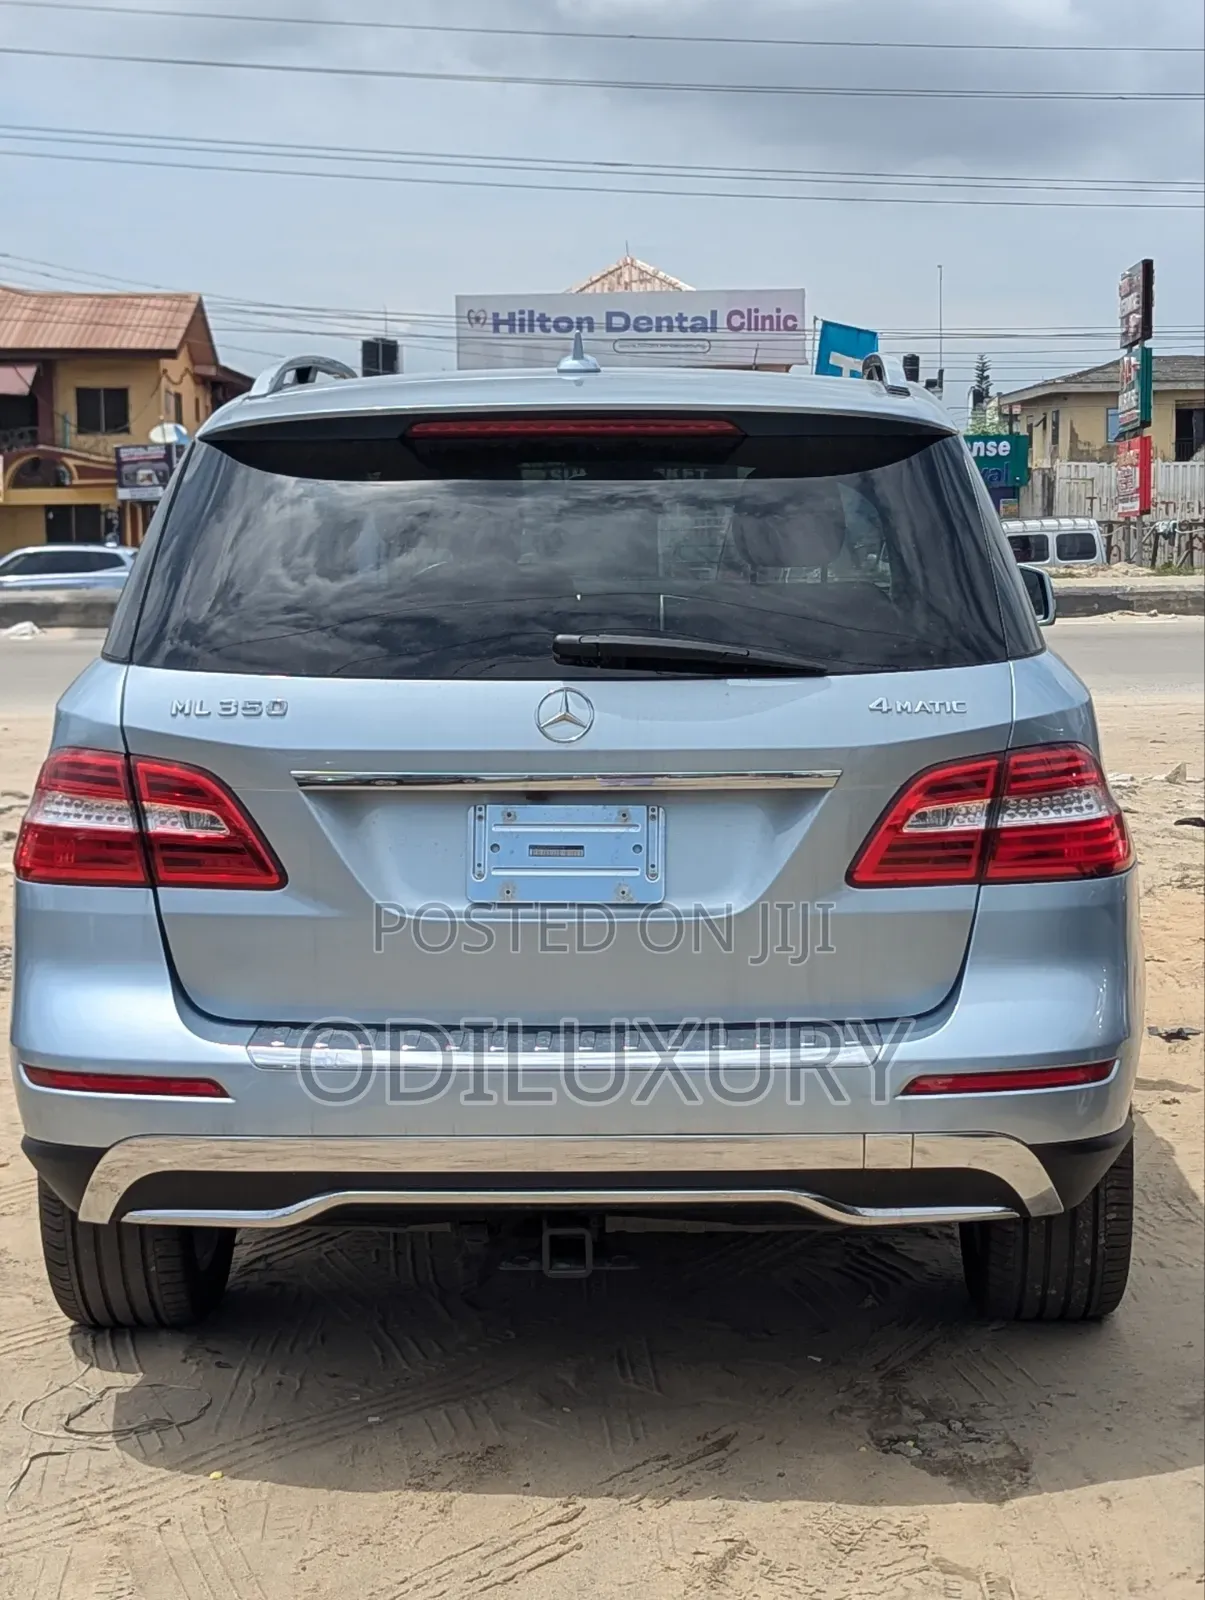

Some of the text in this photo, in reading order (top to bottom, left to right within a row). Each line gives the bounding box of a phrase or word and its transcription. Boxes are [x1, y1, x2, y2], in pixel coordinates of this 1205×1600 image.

[492, 307, 798, 334] Hilton Dental Clinic
[967, 440, 1011, 457] nse
[170, 699, 288, 717] ML 350
